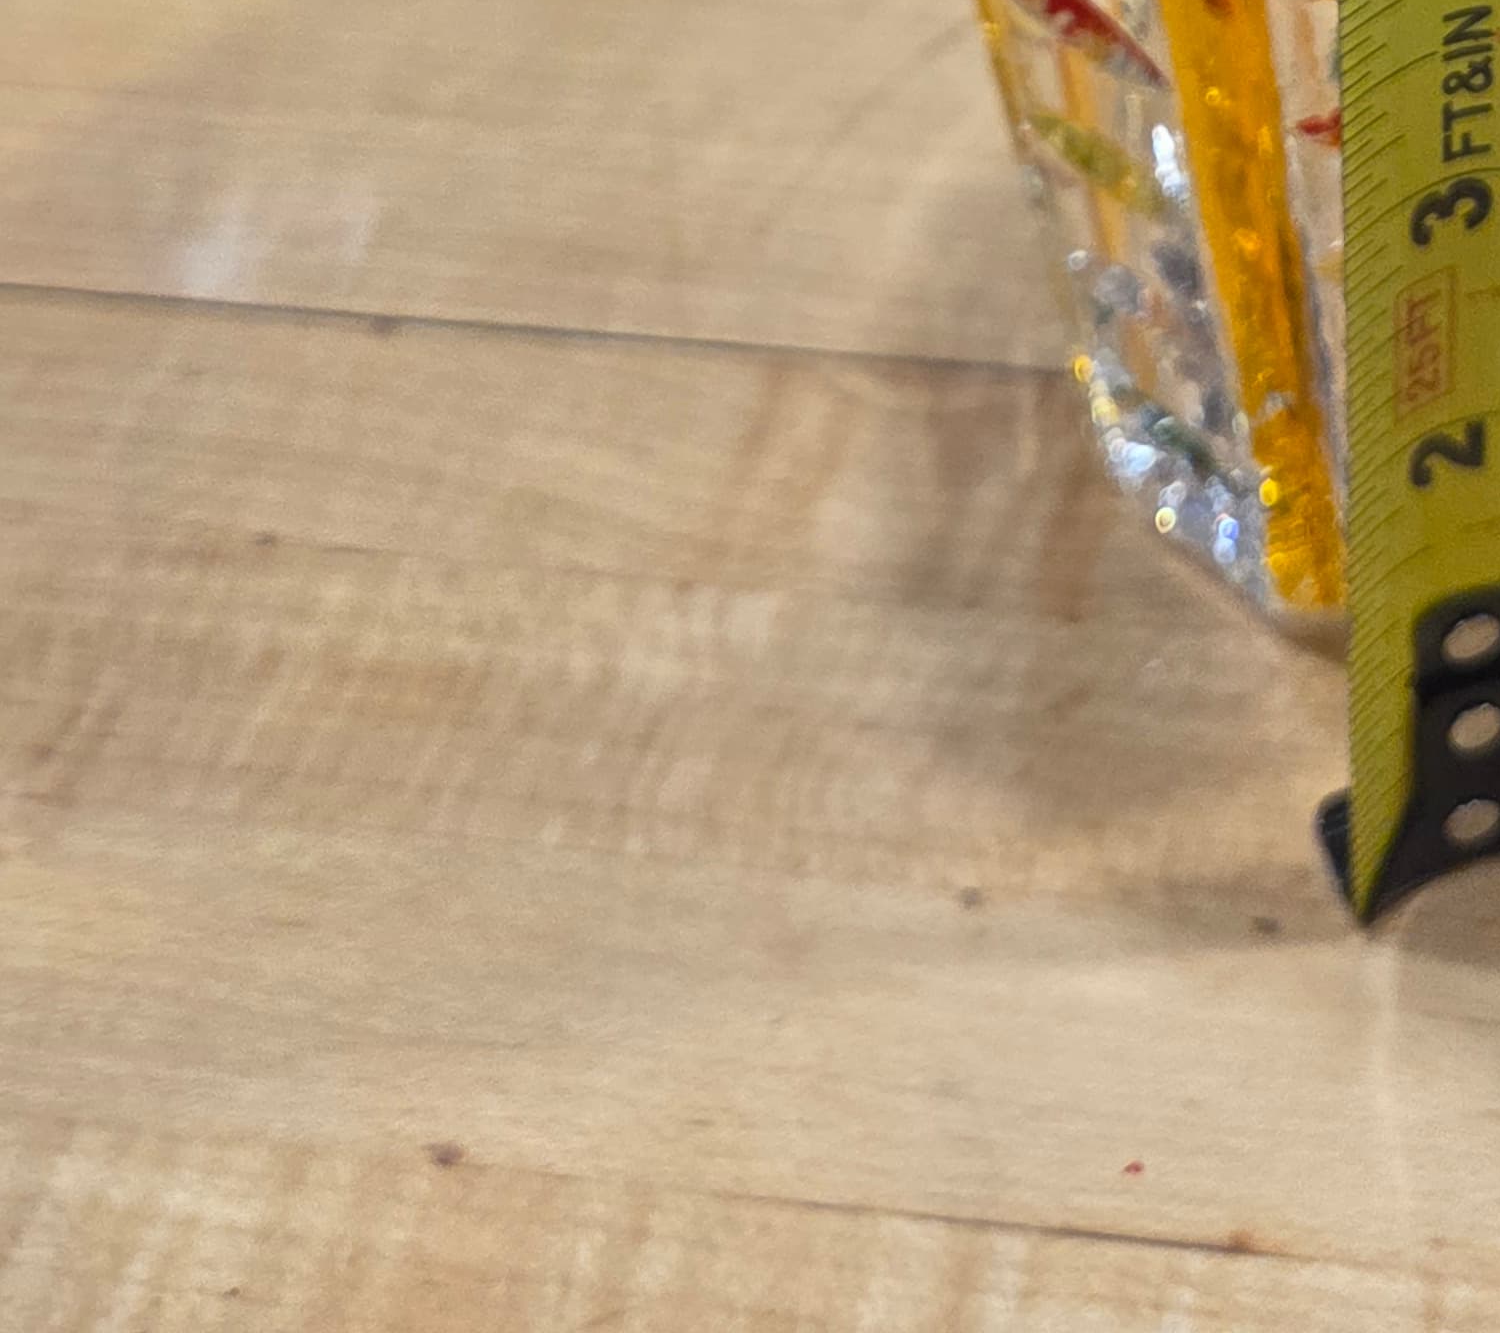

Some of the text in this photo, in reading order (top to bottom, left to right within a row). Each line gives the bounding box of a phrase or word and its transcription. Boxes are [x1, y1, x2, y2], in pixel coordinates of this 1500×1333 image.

[1441, 3, 1495, 162] FT&IN
[1409, 176, 1494, 247] 3
[1409, 415, 1487, 488] 2
